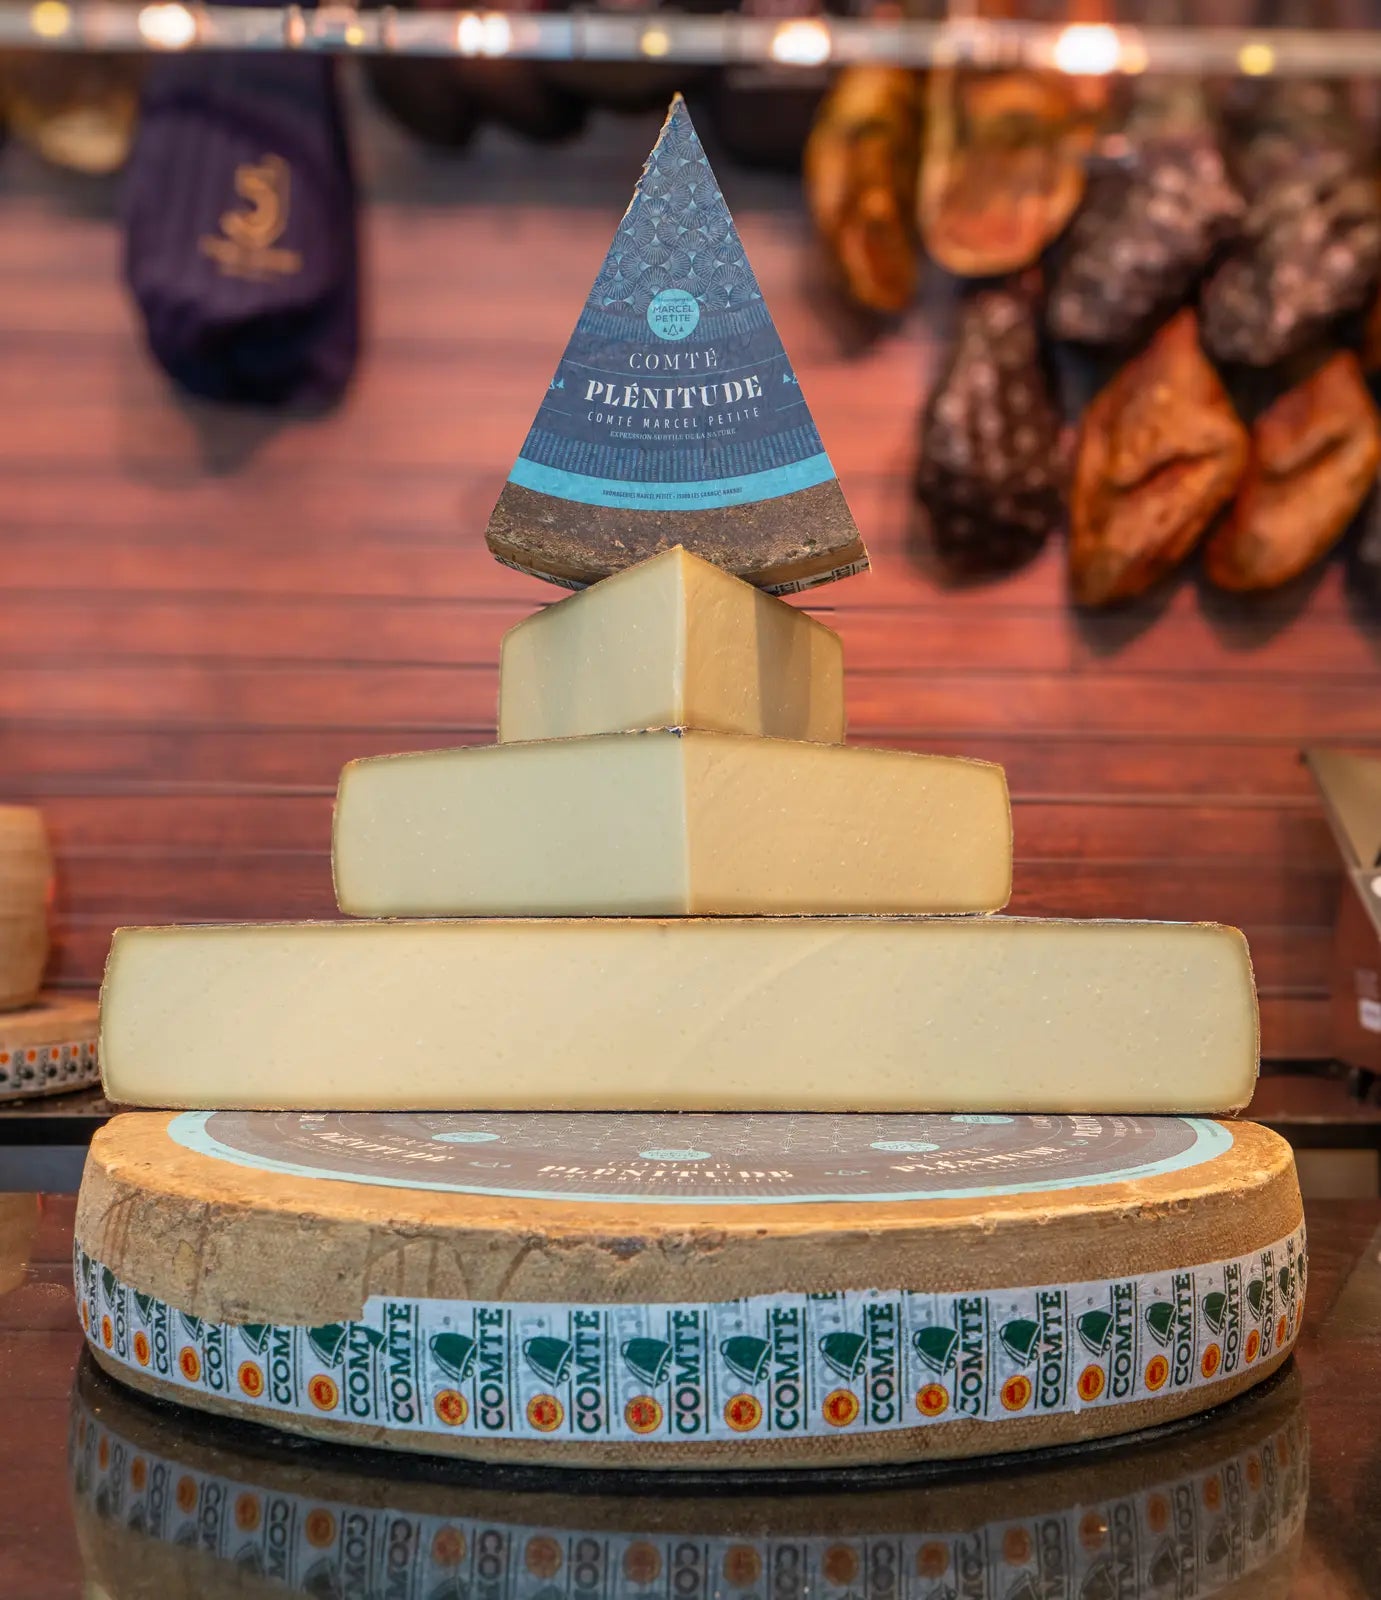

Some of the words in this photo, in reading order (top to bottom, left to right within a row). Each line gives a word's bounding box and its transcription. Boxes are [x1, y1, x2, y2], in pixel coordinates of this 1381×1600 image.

[653, 304, 694, 313] MARCEL
[655, 314, 691, 322] PETITE
[629, 347, 717, 370] COMTÉ
[583, 375, 763, 409] PLÉNITUDE
[587, 411, 633, 427] COMTÉ
[643, 417, 698, 429] MARCEL
[708, 407, 760, 426] PETITE
